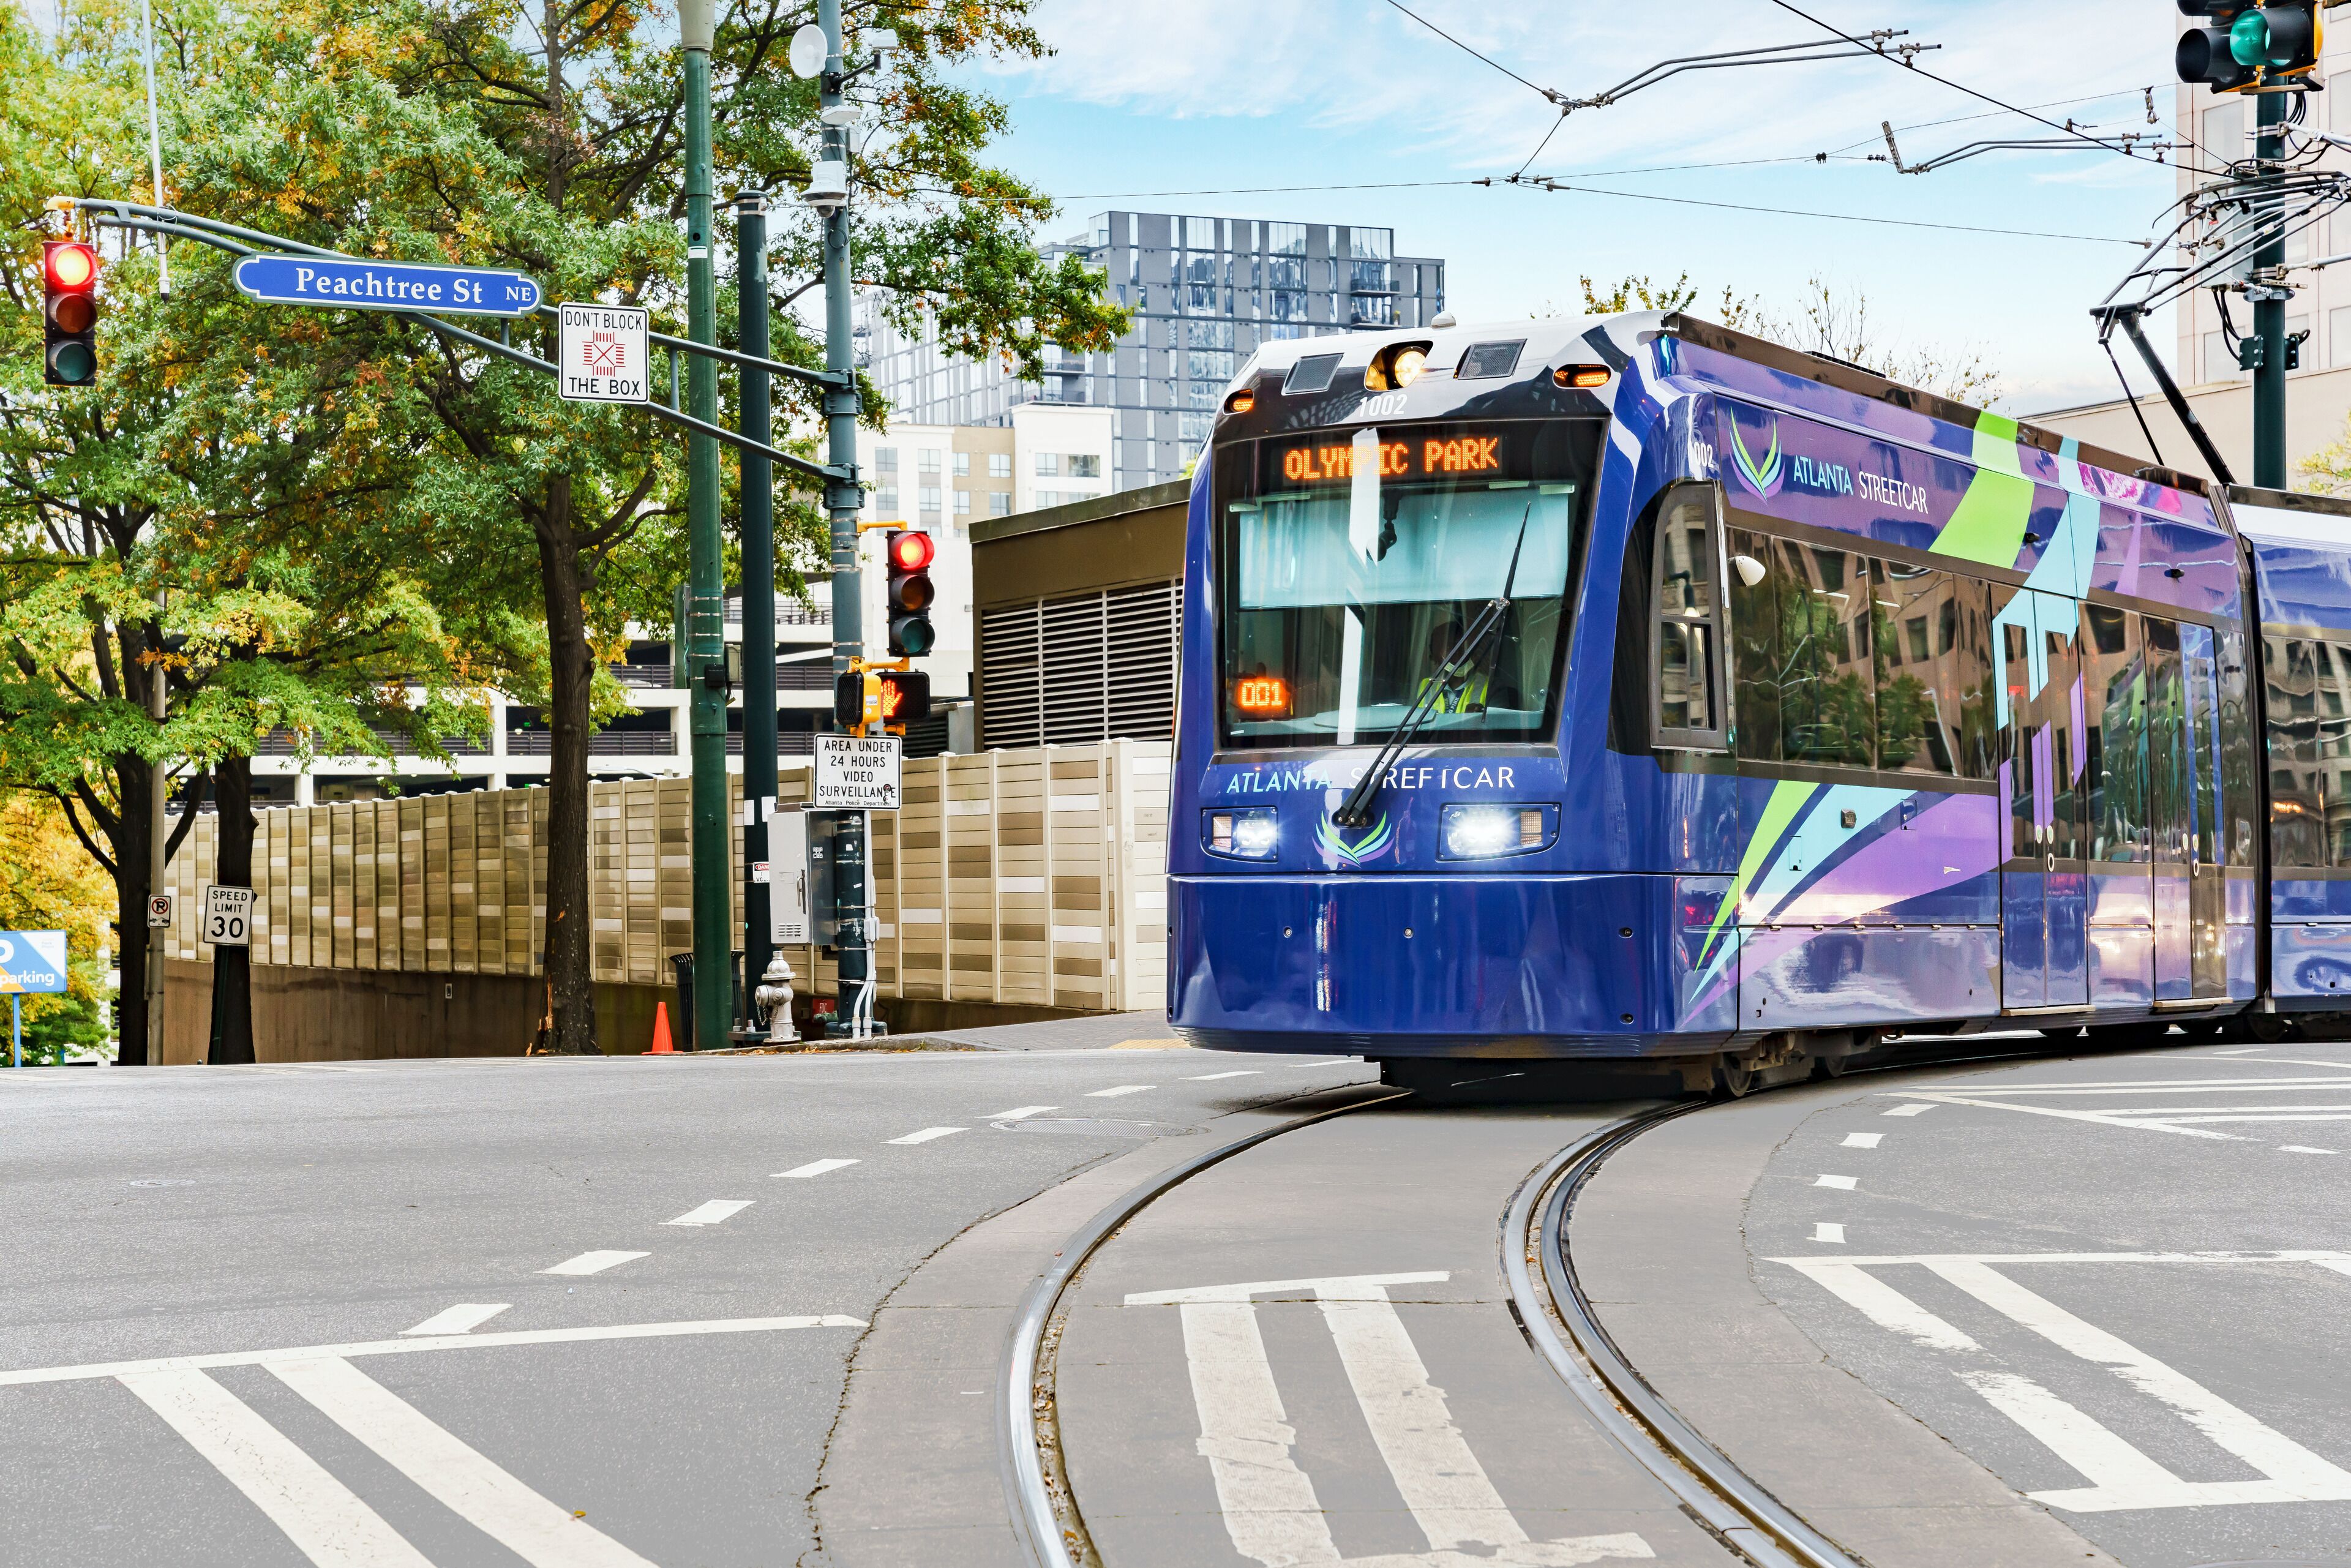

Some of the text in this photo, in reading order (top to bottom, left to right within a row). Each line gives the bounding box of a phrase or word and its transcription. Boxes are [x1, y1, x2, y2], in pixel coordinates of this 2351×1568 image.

[295, 267, 532, 304] Peachtree St NE
[565, 310, 642, 330] DON'T BLOCK
[568, 377, 640, 396] THE BOX
[1359, 394, 1408, 418] 1002
[1285, 437, 1498, 479] OLYMPIC PARK
[1793, 455, 1929, 514] ATLANTA STREETCAR
[1242, 681, 1282, 706] 001
[824, 740, 892, 752] AREA UNDER
[830, 755, 885, 767] 24 HOURS
[843, 771, 873, 782] VIDEO
[1226, 771, 1332, 793] ATLANTA
[819, 785, 896, 798] SURVEILLANE
[212, 890, 247, 901] SPEED
[215, 903, 243, 913] LIMIT
[211, 916, 244, 938] 30
[0, 970, 54, 986] parking
